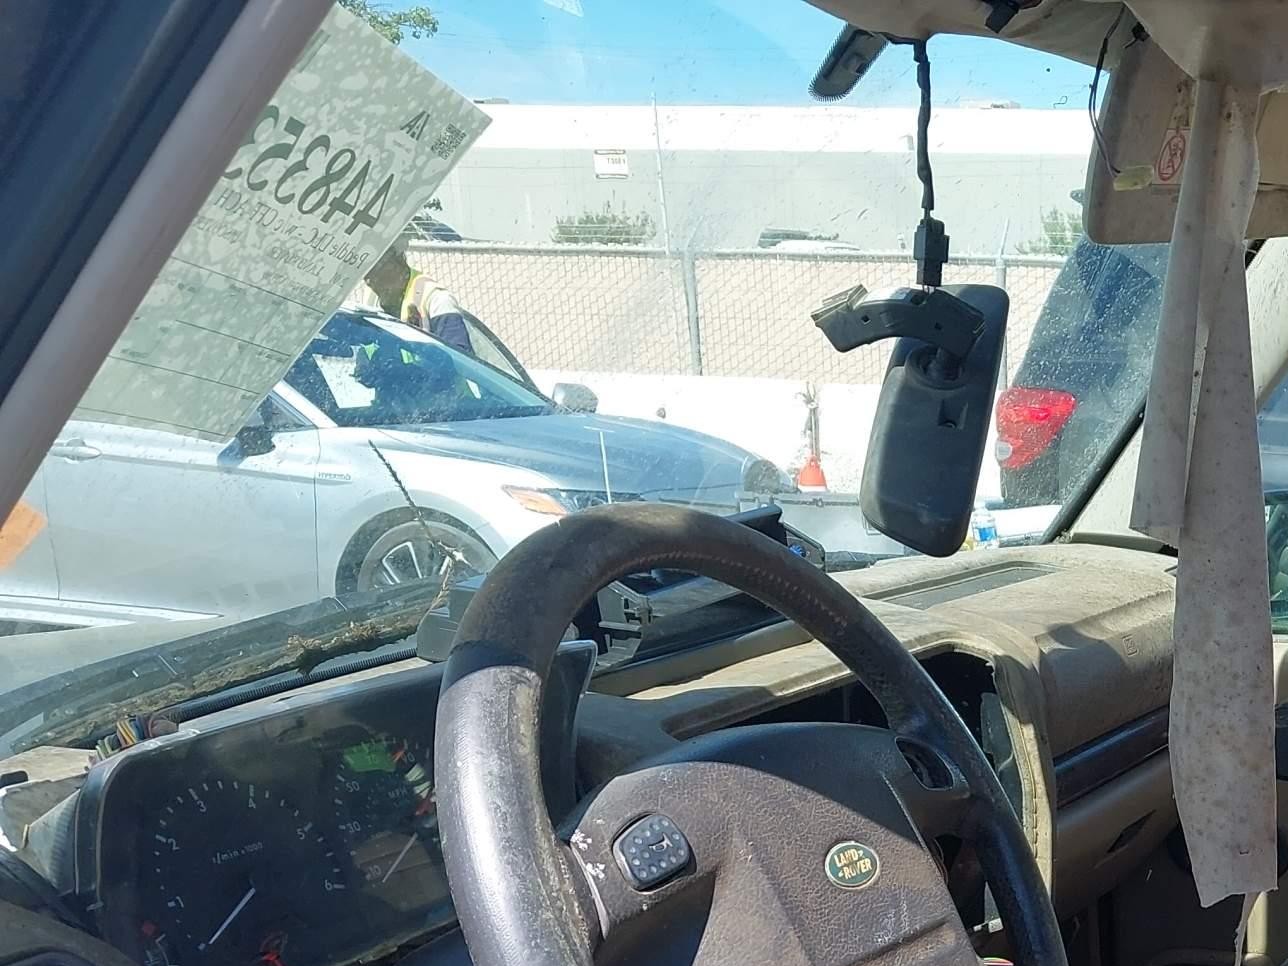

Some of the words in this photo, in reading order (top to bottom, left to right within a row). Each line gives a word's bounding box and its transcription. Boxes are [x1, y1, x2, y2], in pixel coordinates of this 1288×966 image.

[197, 800, 207, 812] 3
[248, 799, 256, 809] 4
[297, 829, 305, 840] 5
[168, 838, 180, 851] 2
[834, 848, 858, 867] LAND
[843, 858, 872, 880] ROVER
[325, 880, 333, 891] 6
